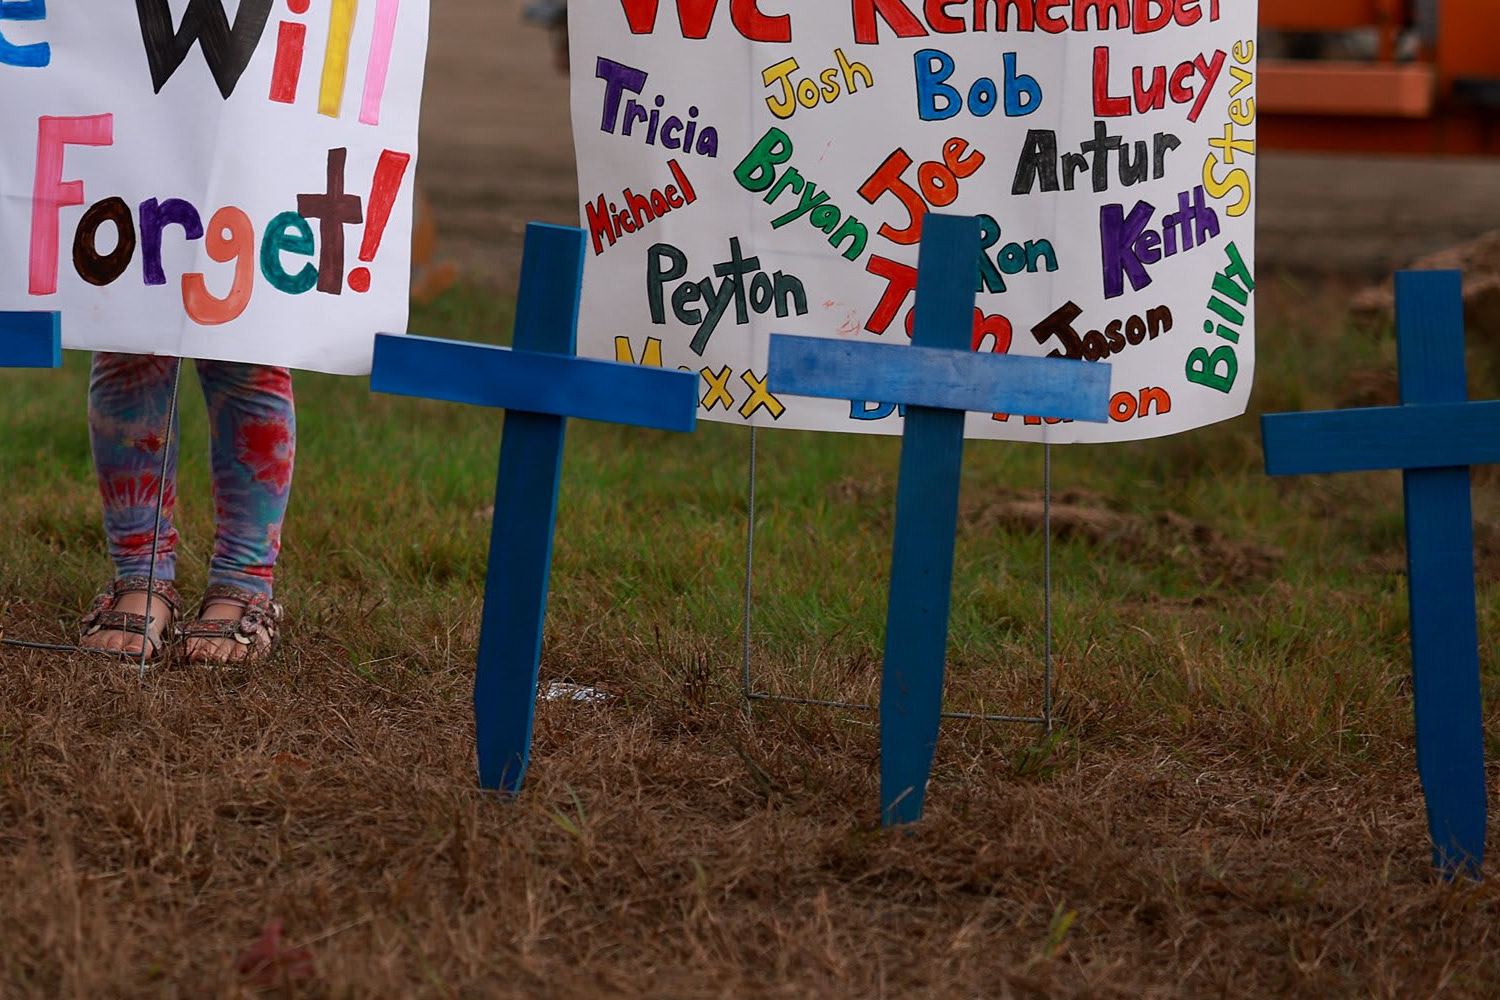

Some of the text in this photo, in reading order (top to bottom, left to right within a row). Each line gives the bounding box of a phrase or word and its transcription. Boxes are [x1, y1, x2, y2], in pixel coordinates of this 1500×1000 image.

[595, 56, 719, 158] Tricia
[761, 48, 874, 119] Josh
[913, 49, 1043, 121] Bob
[1092, 46, 1227, 123] Lucy
[1202, 39, 1255, 217] Steve
[585, 159, 697, 256] Michael
[733, 126, 869, 262] Bryan
[857, 136, 985, 246] Joe
[1011, 120, 1182, 195] Artur
[28, 113, 411, 326] Forget!
[975, 213, 1059, 293] Ron
[1100, 185, 1221, 299] Keith
[646, 236, 809, 357] Peyton
[1030, 300, 1173, 362] Jason
[1185, 240, 1256, 394] Billy
